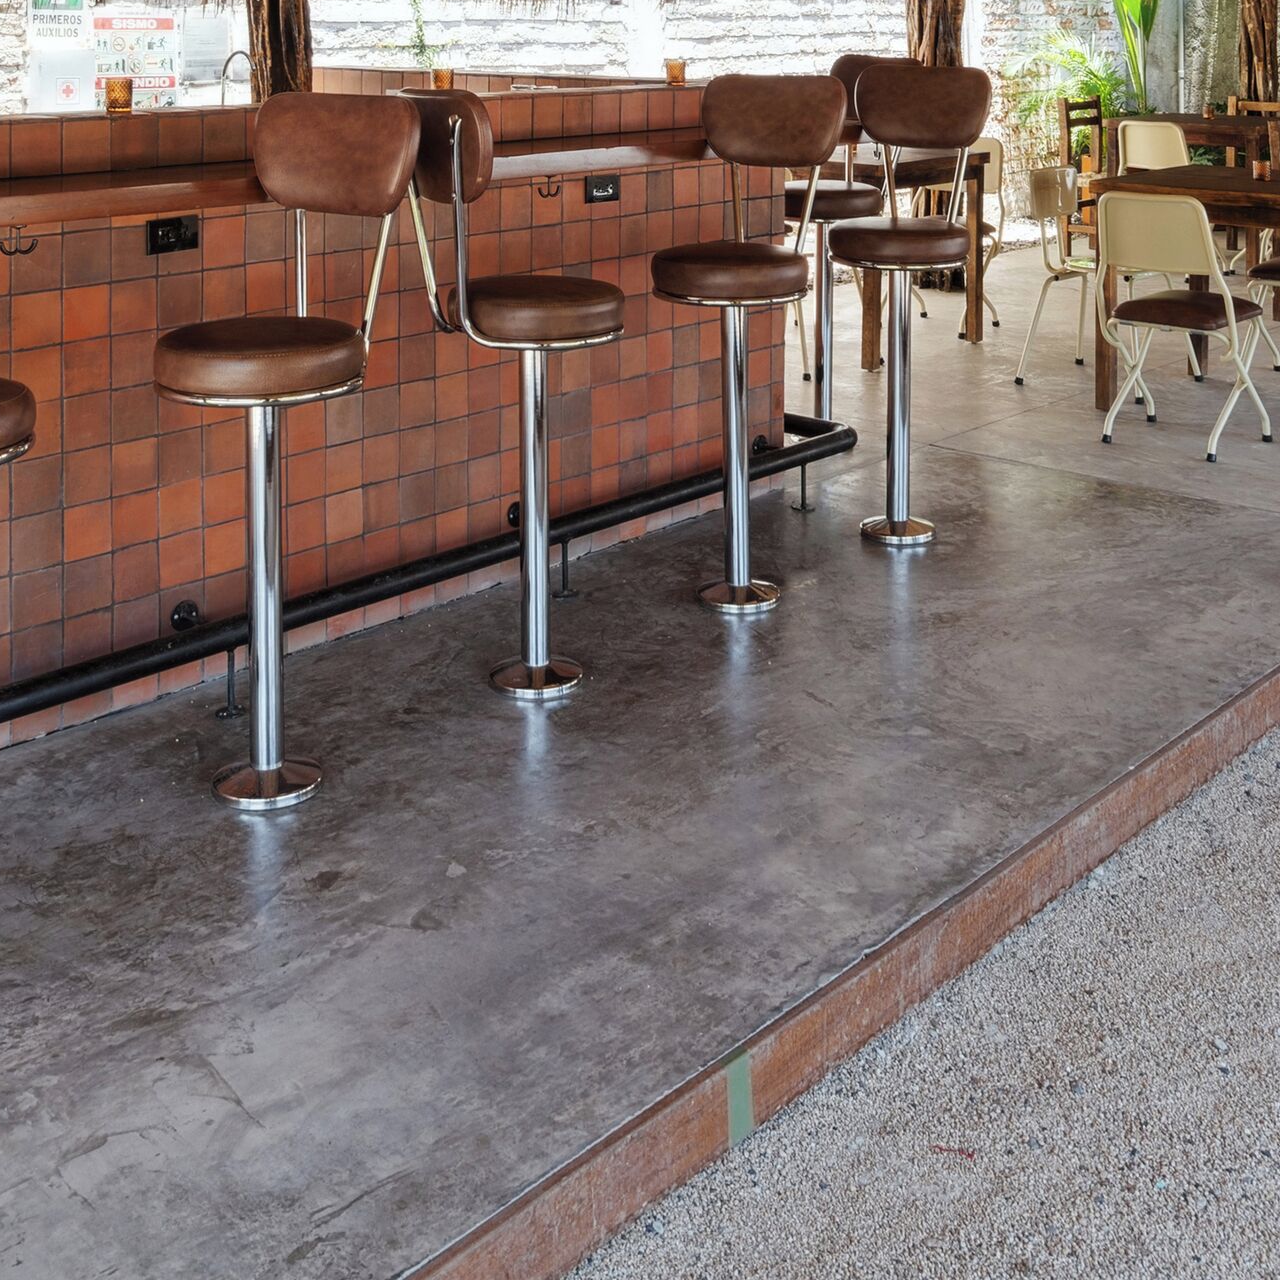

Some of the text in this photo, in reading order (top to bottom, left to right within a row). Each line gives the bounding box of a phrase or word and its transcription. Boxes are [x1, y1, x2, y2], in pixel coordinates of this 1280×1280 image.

[32, 14, 82, 25] PRIMEROS
[111, 19, 158, 29] SISMO
[36, 27, 79, 38] AUXILIOS
[101, 76, 170, 88] IENDIO
